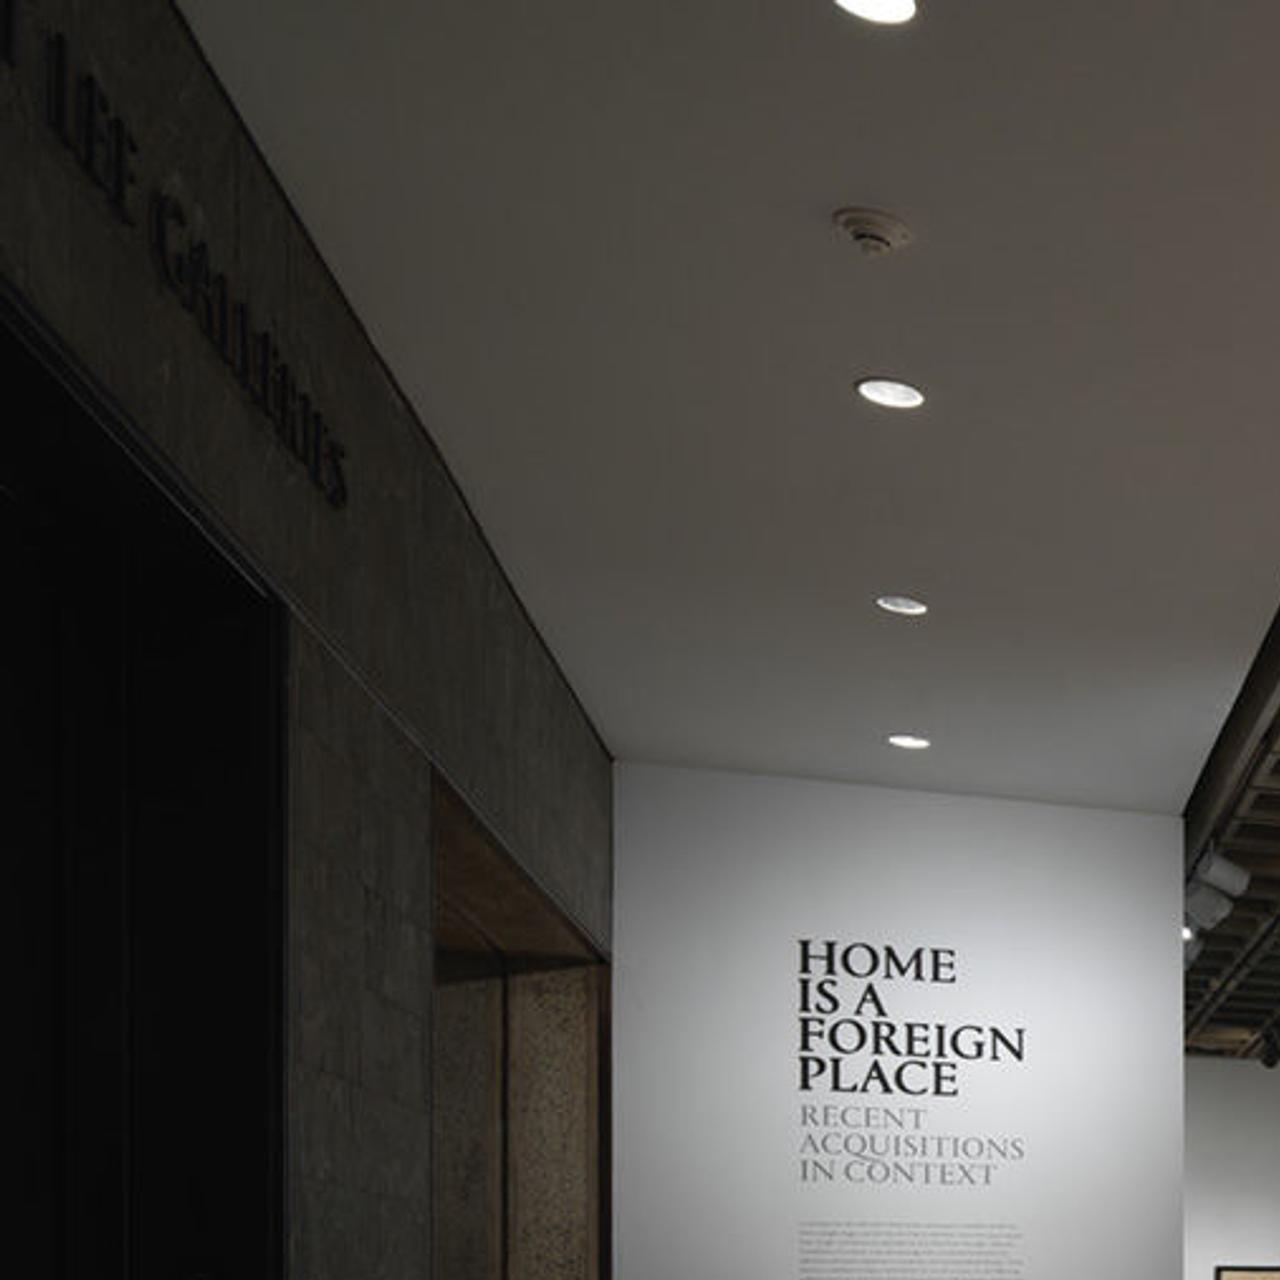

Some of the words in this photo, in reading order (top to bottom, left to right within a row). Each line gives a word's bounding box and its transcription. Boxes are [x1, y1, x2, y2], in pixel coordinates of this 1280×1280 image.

[798, 939, 957, 984] HOME
[798, 978, 840, 1015] IS
[854, 982, 887, 1018] A
[798, 1016, 1026, 1062] FOREIGN
[798, 1055, 959, 1098] PLACE
[800, 1104, 927, 1130] RECENT
[799, 1131, 1026, 1162] ACQUISITIONS
[800, 1158, 835, 1184] IN
[843, 1158, 998, 1186] CONTEXT
